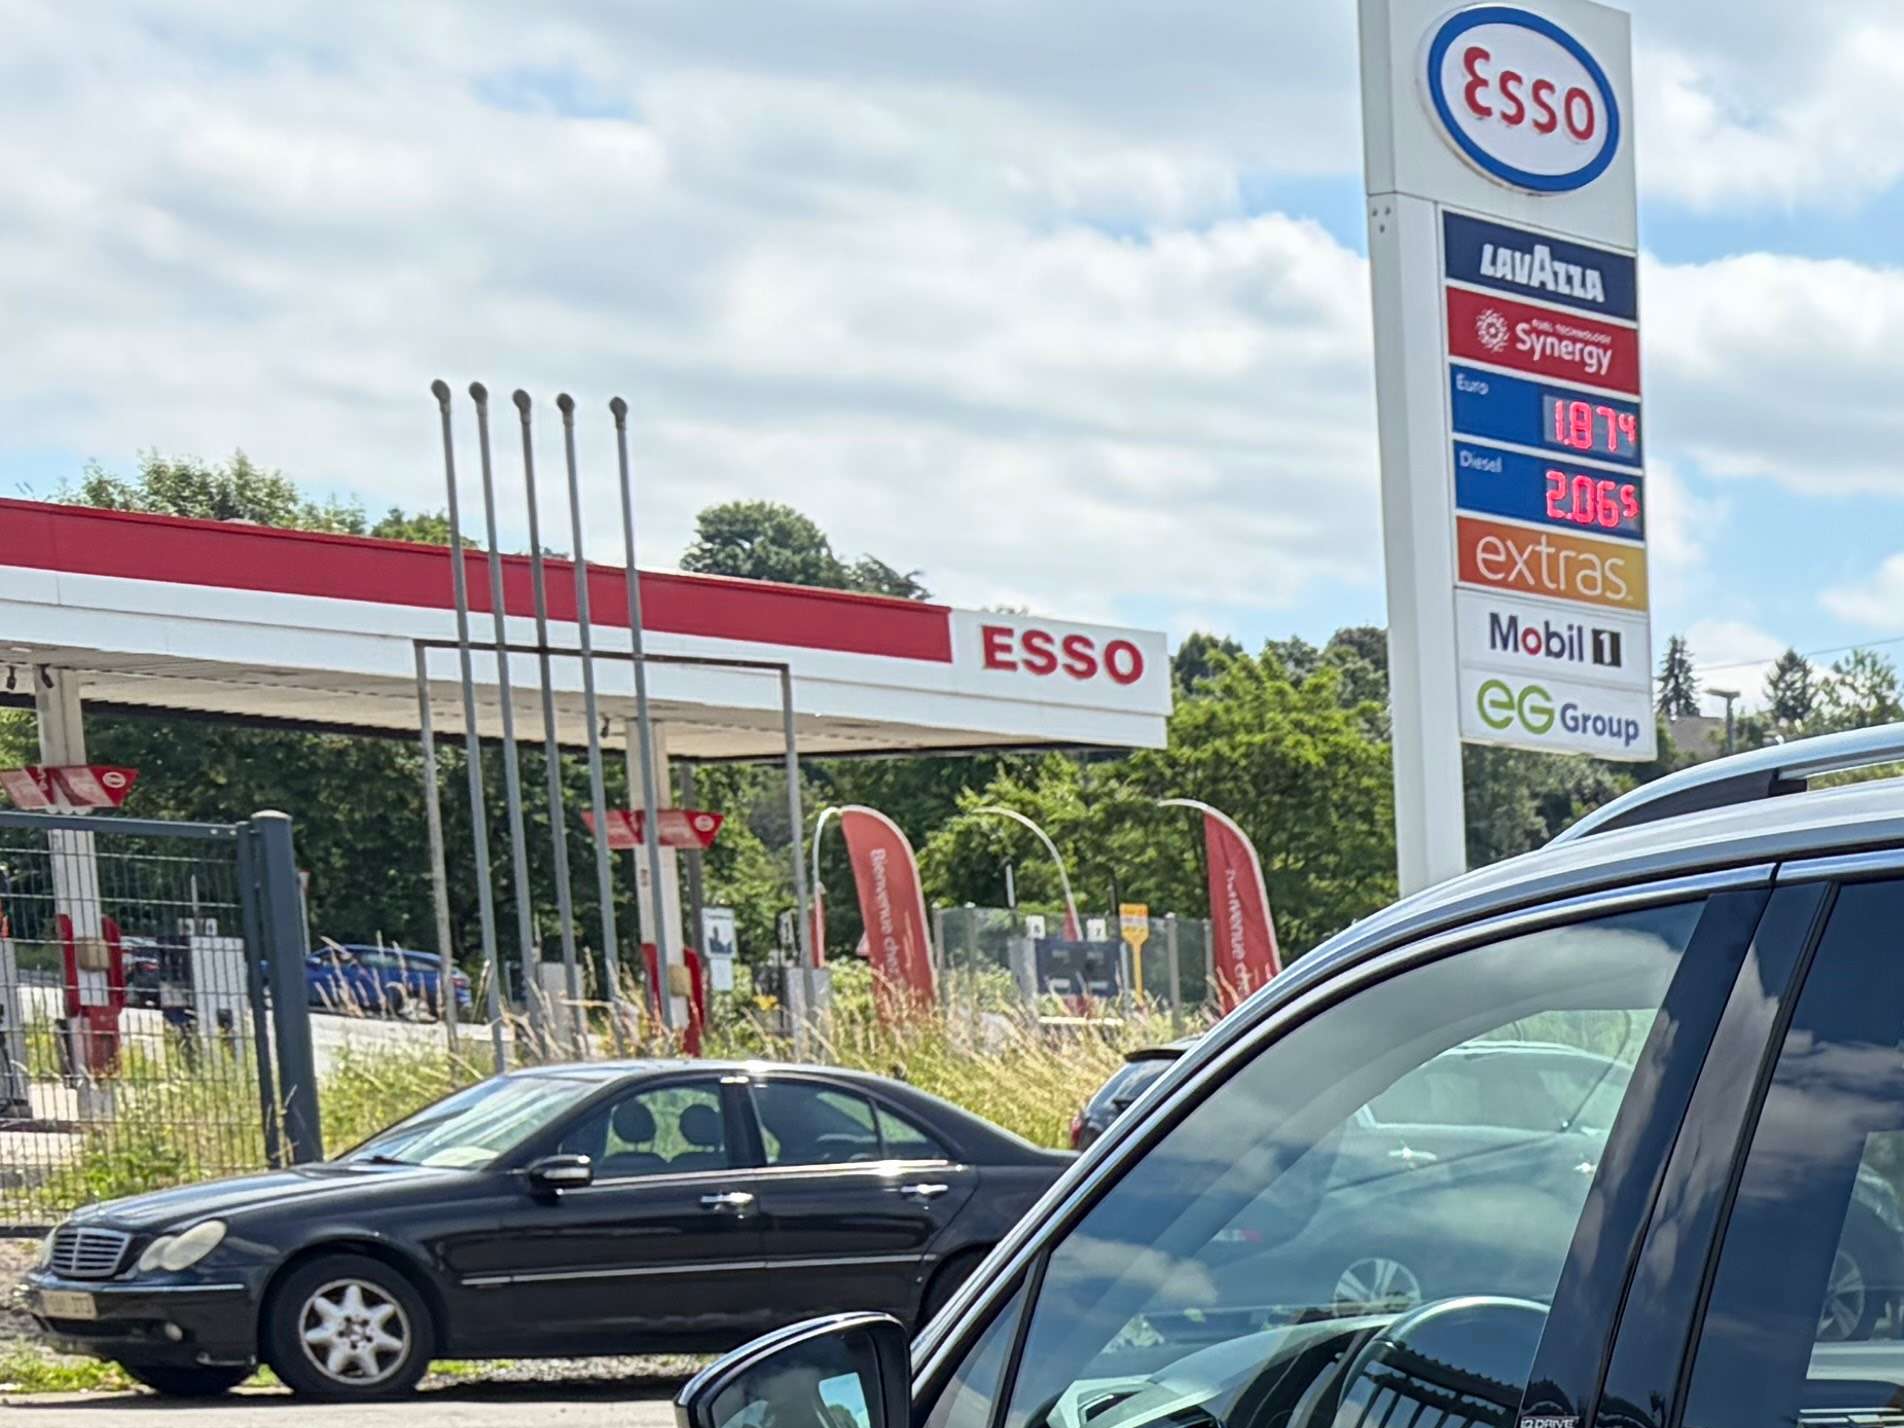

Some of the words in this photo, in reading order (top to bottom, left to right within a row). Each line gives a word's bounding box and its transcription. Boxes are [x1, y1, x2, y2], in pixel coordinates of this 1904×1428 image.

[1480, 243, 1605, 302] LAVAZZA
[1515, 322, 1612, 375] Synergy
[1459, 450, 1502, 472] Diesel
[1476, 535, 1628, 601] extras
[982, 625, 1144, 686] ESSO
[1489, 612, 1585, 662] Mobil
[1560, 703, 1640, 746] Group
[869, 848, 894, 935] Bienvenue
